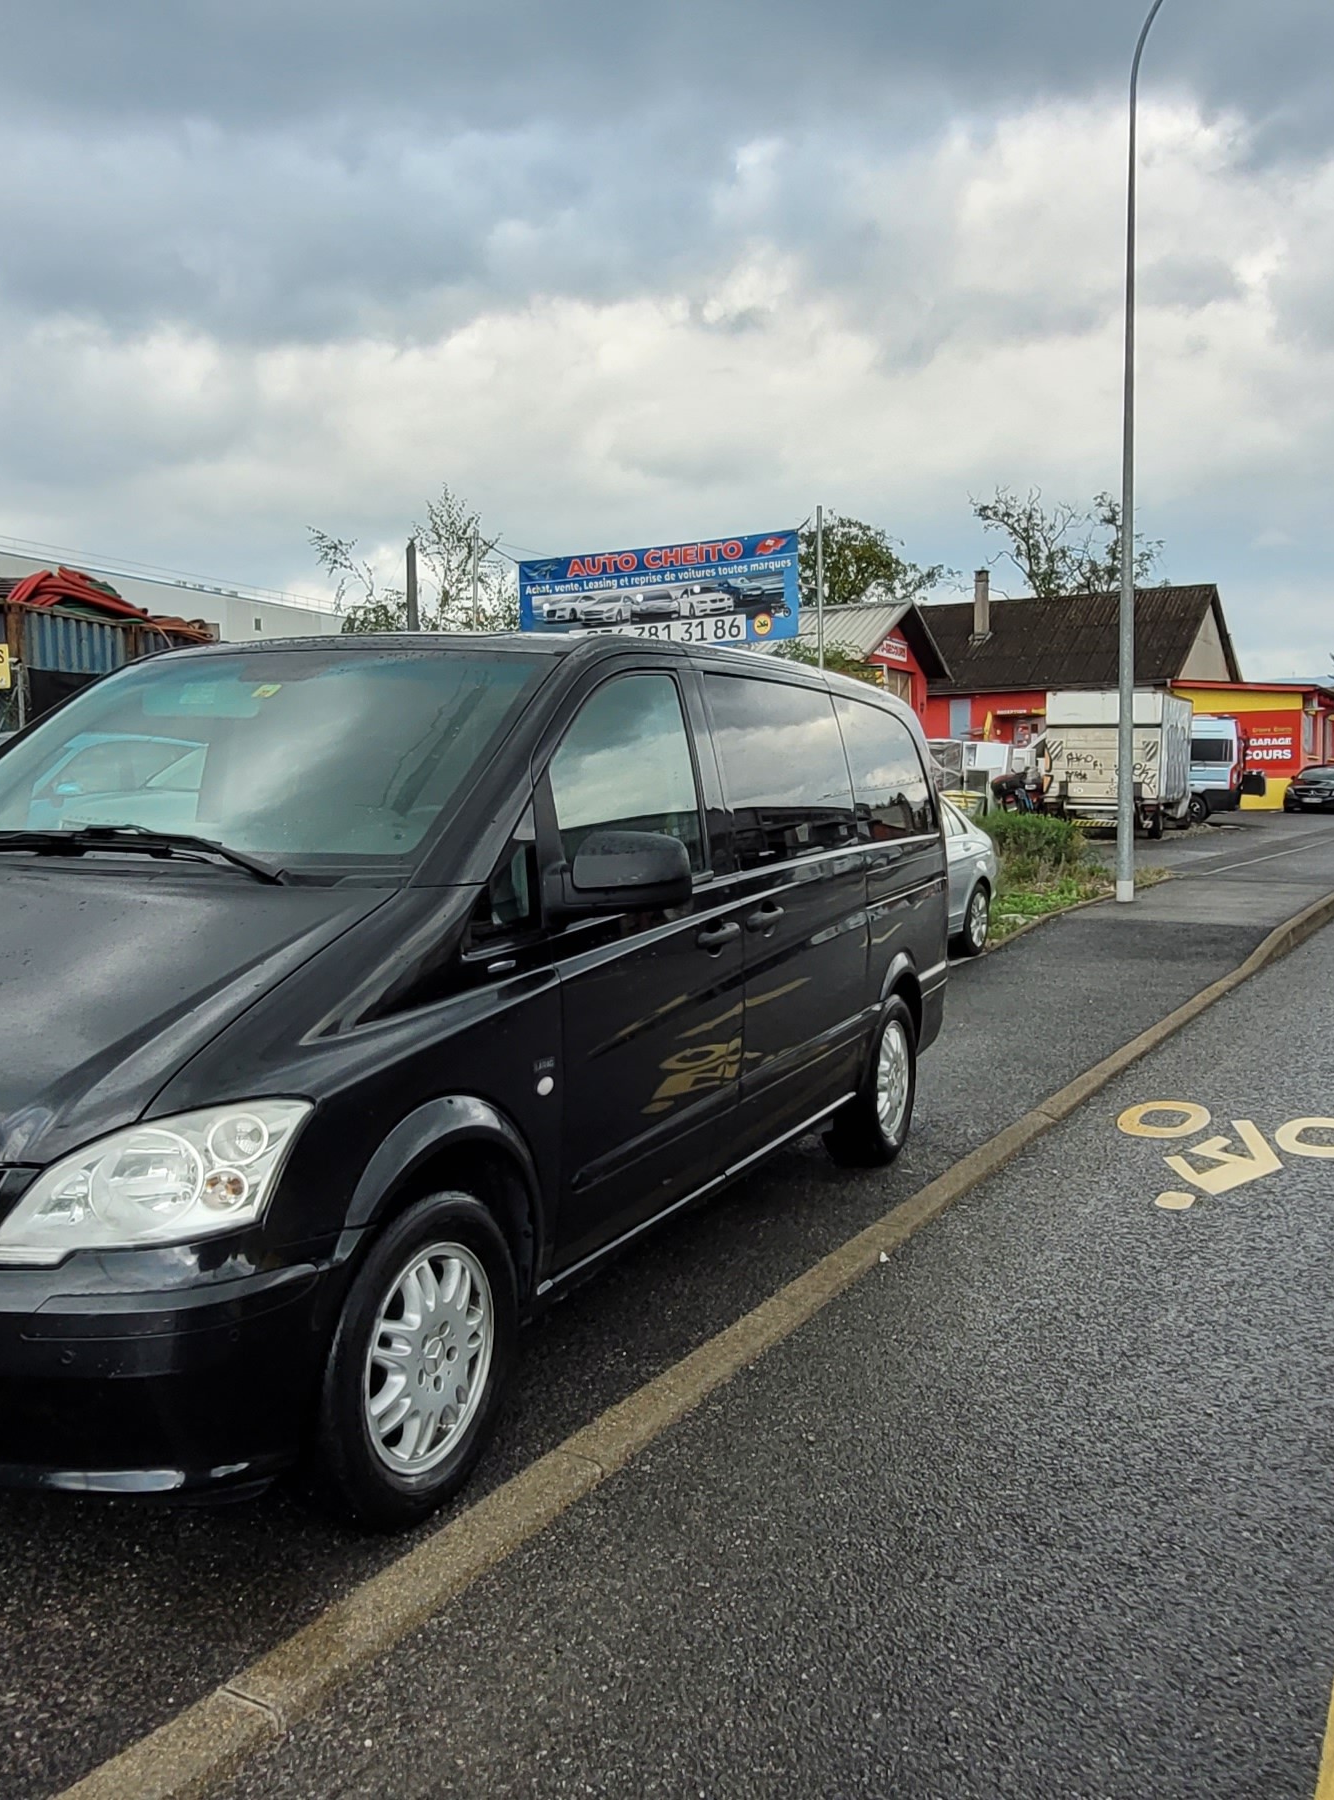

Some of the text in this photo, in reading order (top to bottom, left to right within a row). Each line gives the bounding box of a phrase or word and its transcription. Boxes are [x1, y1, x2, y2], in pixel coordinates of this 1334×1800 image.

[567, 539, 743, 578] AUTO CHEITO
[525, 558, 792, 595] Achat, vente, Leasing et reprise de voitures toutes marques
[680, 619, 708, 642] 31
[713, 617, 741, 639] 86
[1249, 737, 1292, 746] GARAGE
